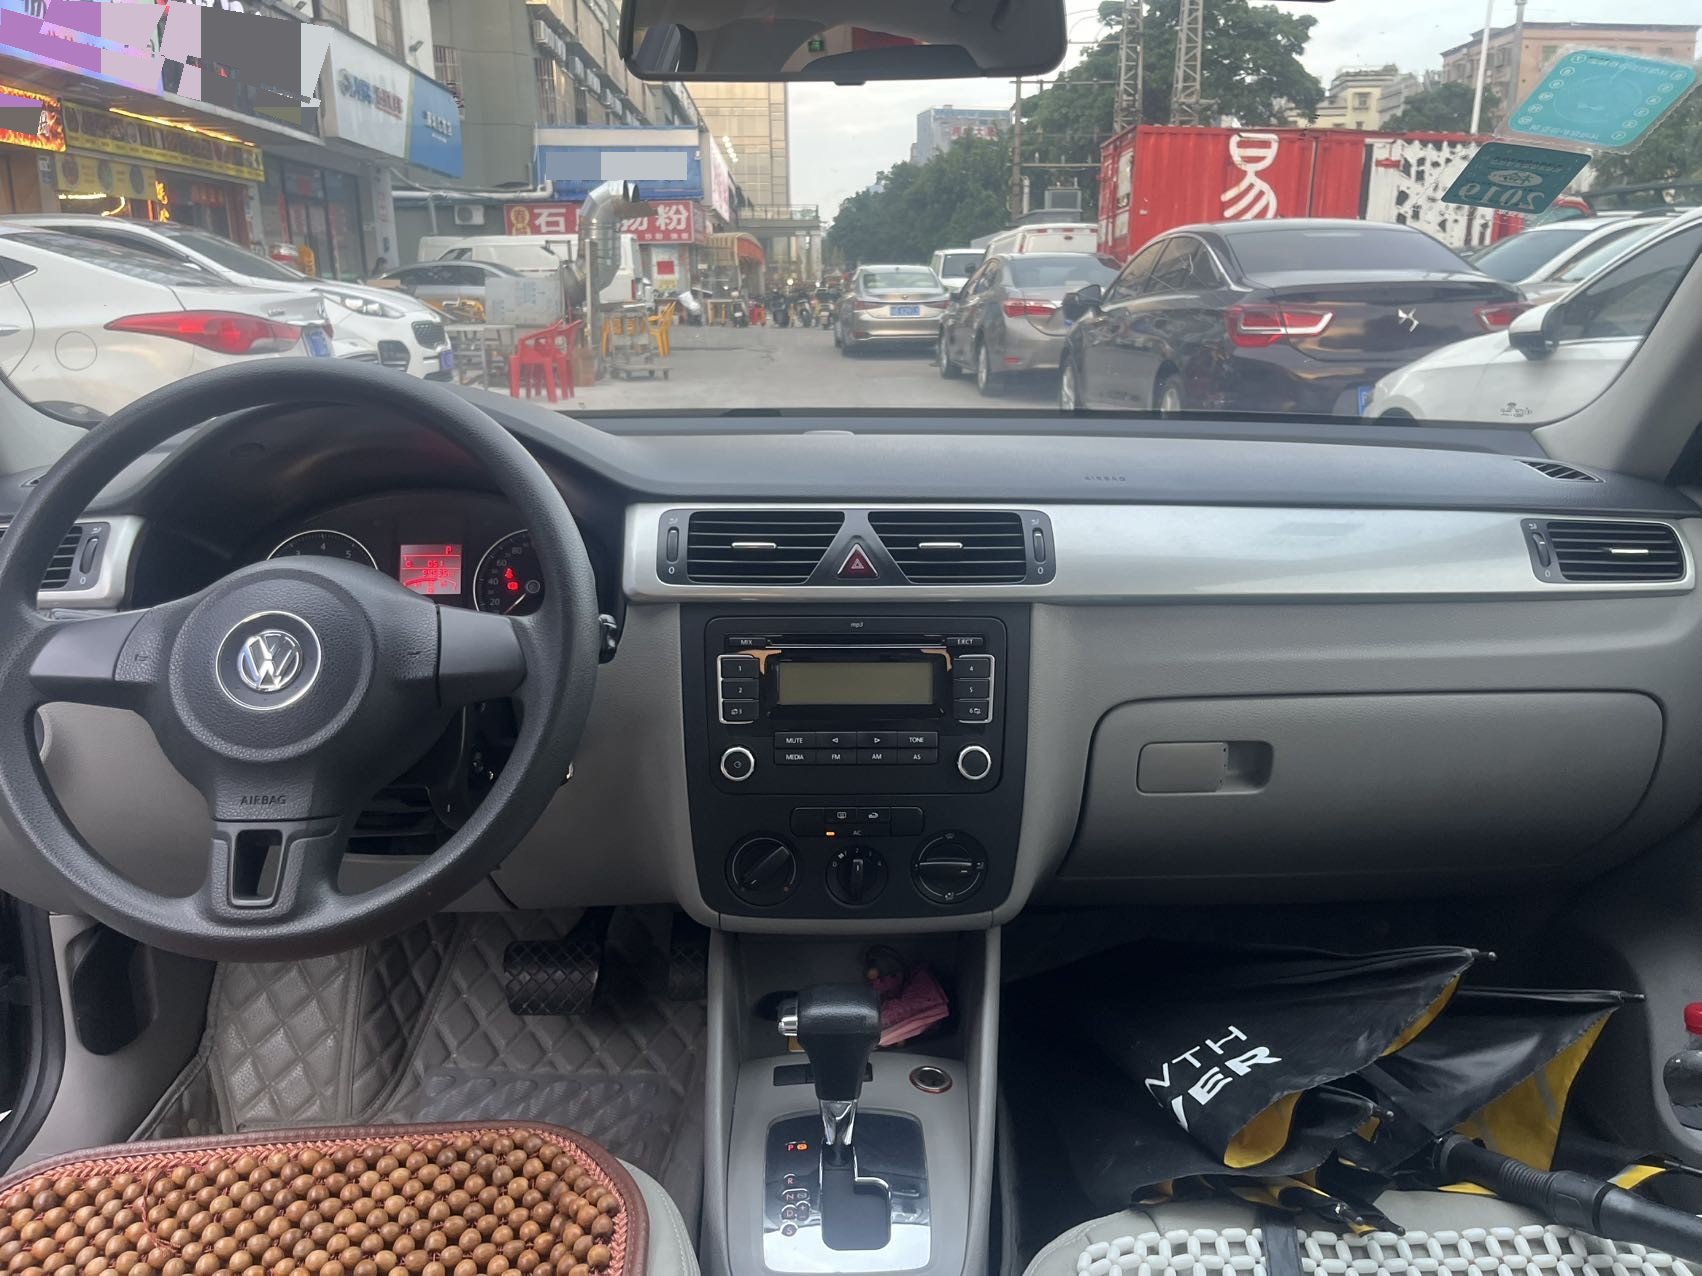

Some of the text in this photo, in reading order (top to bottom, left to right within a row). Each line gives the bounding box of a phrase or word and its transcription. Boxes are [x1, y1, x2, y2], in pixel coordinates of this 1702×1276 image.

[533, 203, 689, 233] 石粉
[320, 542, 327, 551] 4
[345, 550, 352, 558] 5
[496, 559, 508, 567] 60
[487, 577, 499, 585] 40
[489, 598, 501, 606] 20
[850, 621, 864, 629] mp3
[739, 638, 753, 646] MIX
[785, 736, 804, 744] MUTE
[908, 736, 925, 744] TONE
[785, 753, 804, 761] MEDIA
[831, 753, 841, 761] FM
[871, 753, 883, 761] AM
[912, 753, 922, 761] AS
[240, 795, 287, 805] AIRBAG
[786, 1193, 795, 1201] N
[786, 1209, 794, 1217] D
[786, 1226, 793, 1235] S
